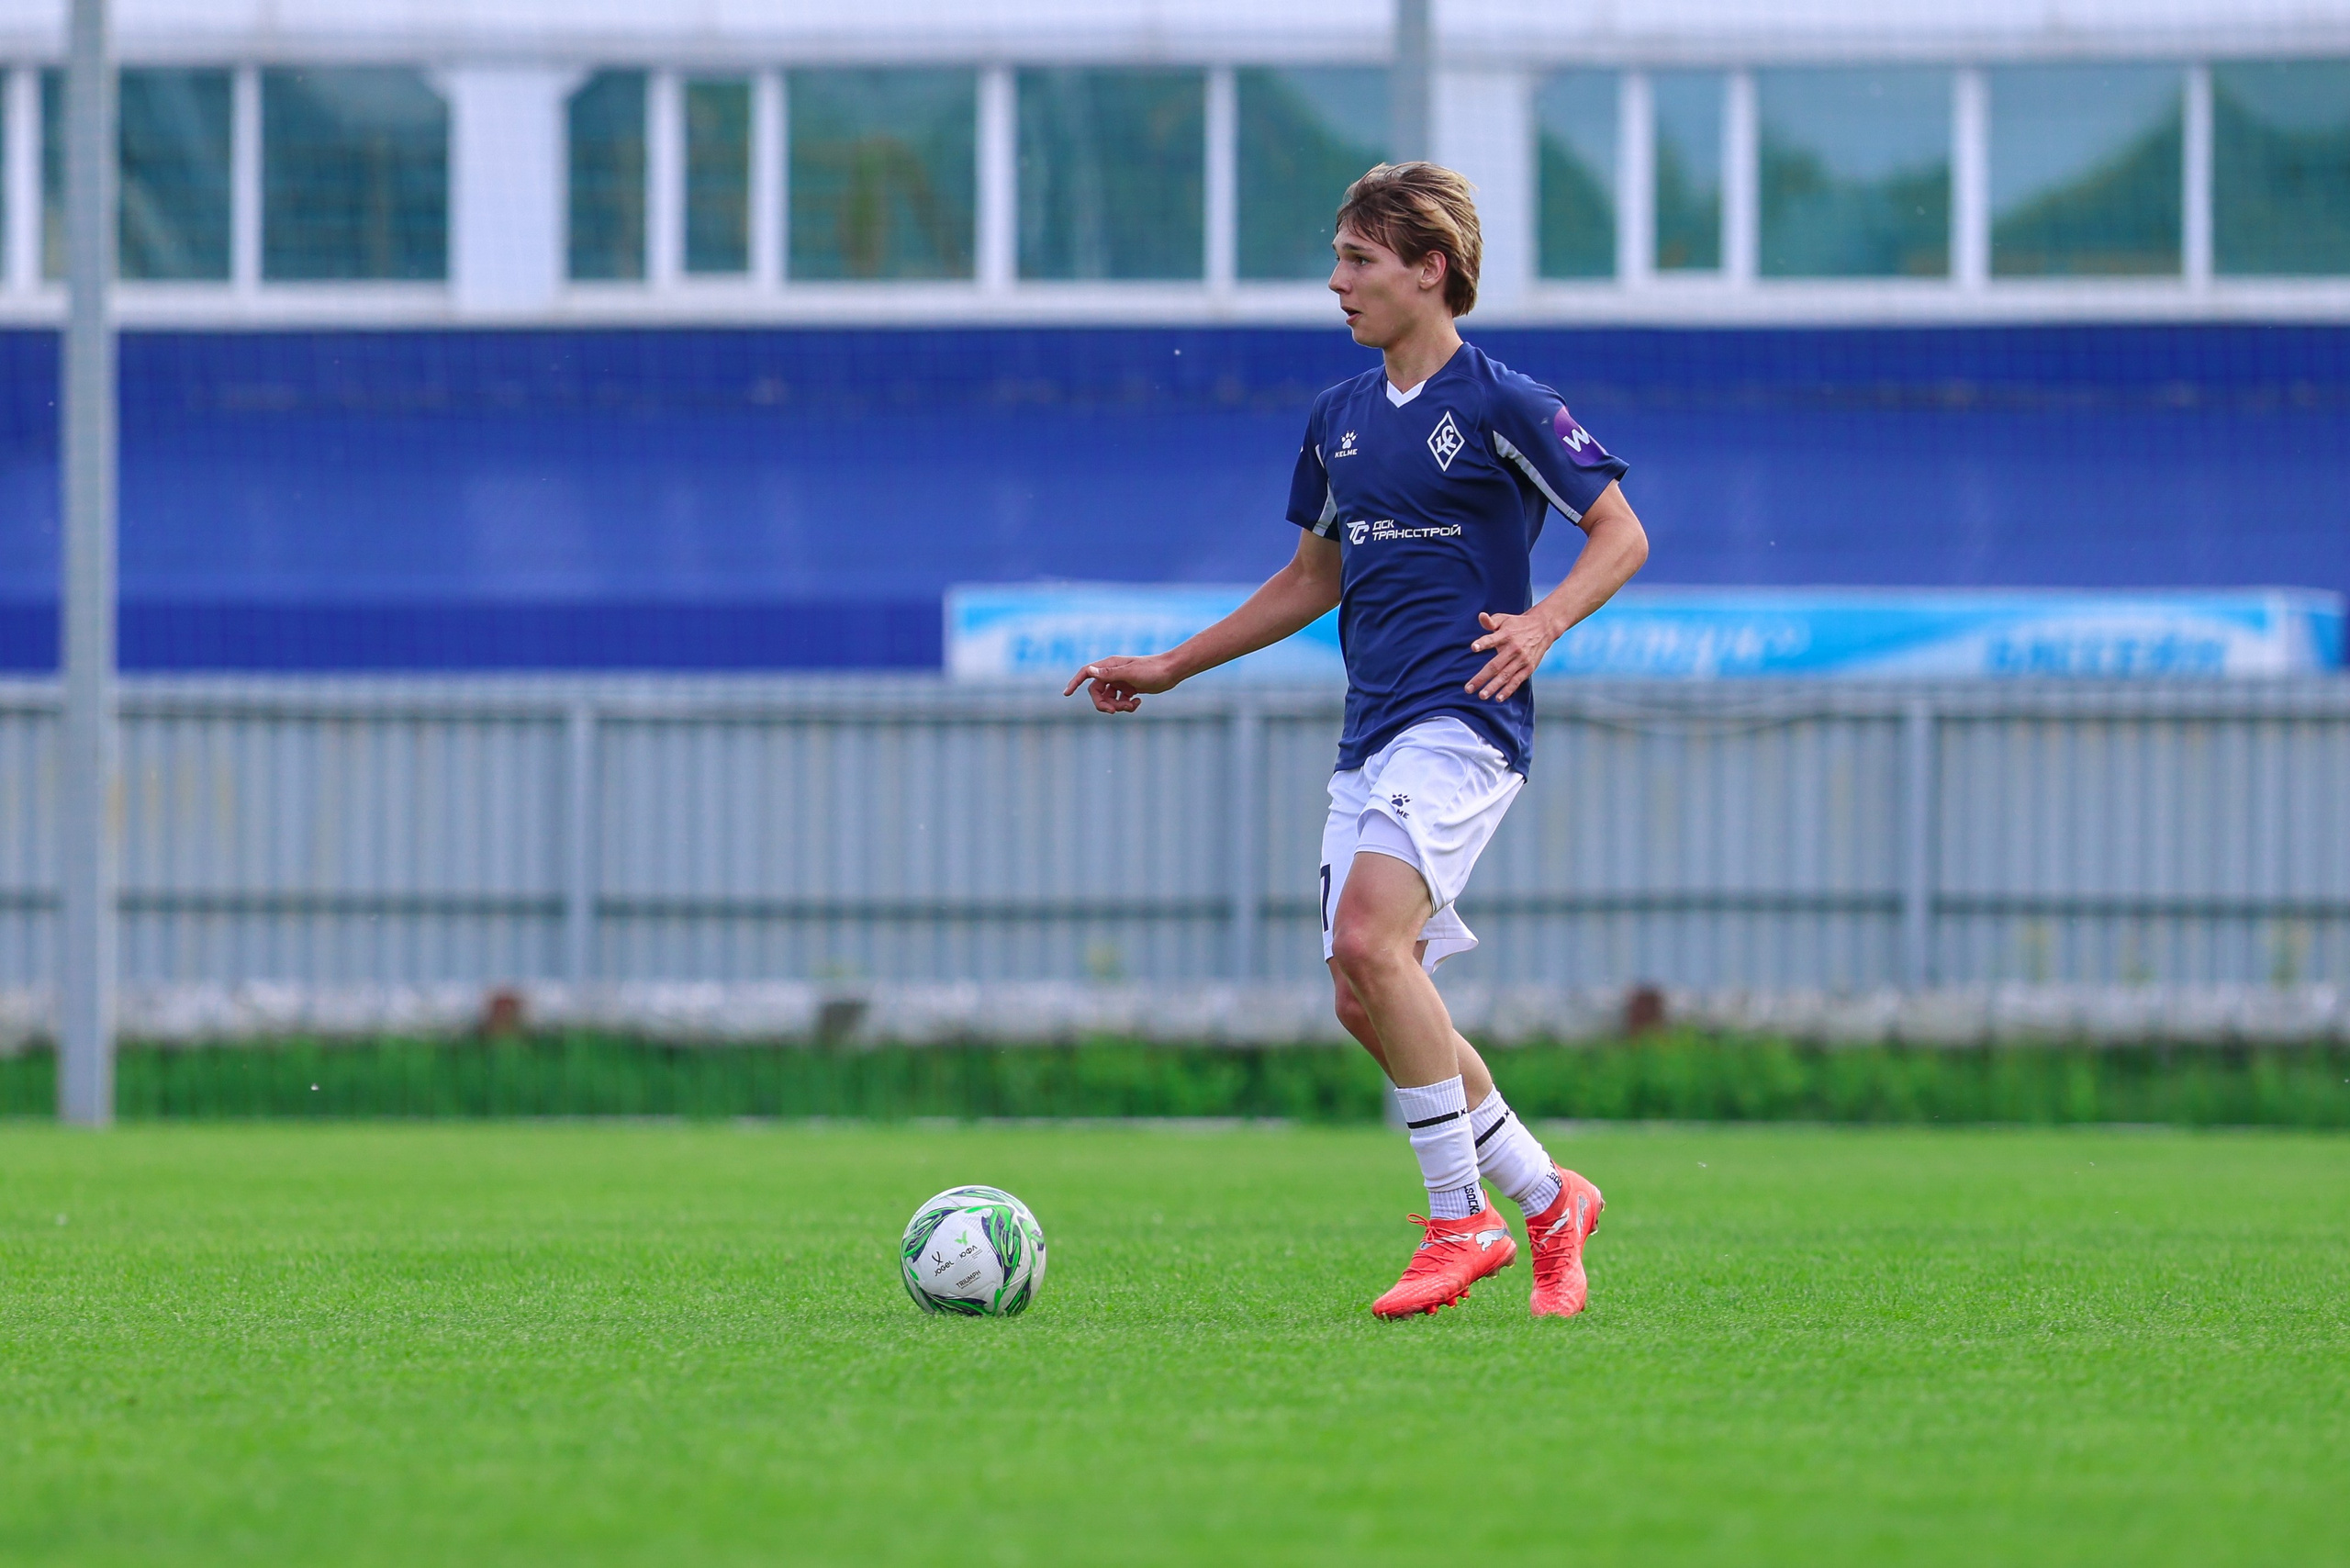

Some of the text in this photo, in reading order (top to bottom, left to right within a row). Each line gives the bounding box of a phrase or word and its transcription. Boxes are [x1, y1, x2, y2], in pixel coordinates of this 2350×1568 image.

[1334, 448, 1358, 458] KELME
[1372, 520, 1394, 531] ДСК
[1372, 524, 1461, 541] ТРАНССТРОЙ
[956, 1269, 981, 1288] TRIUMPH
